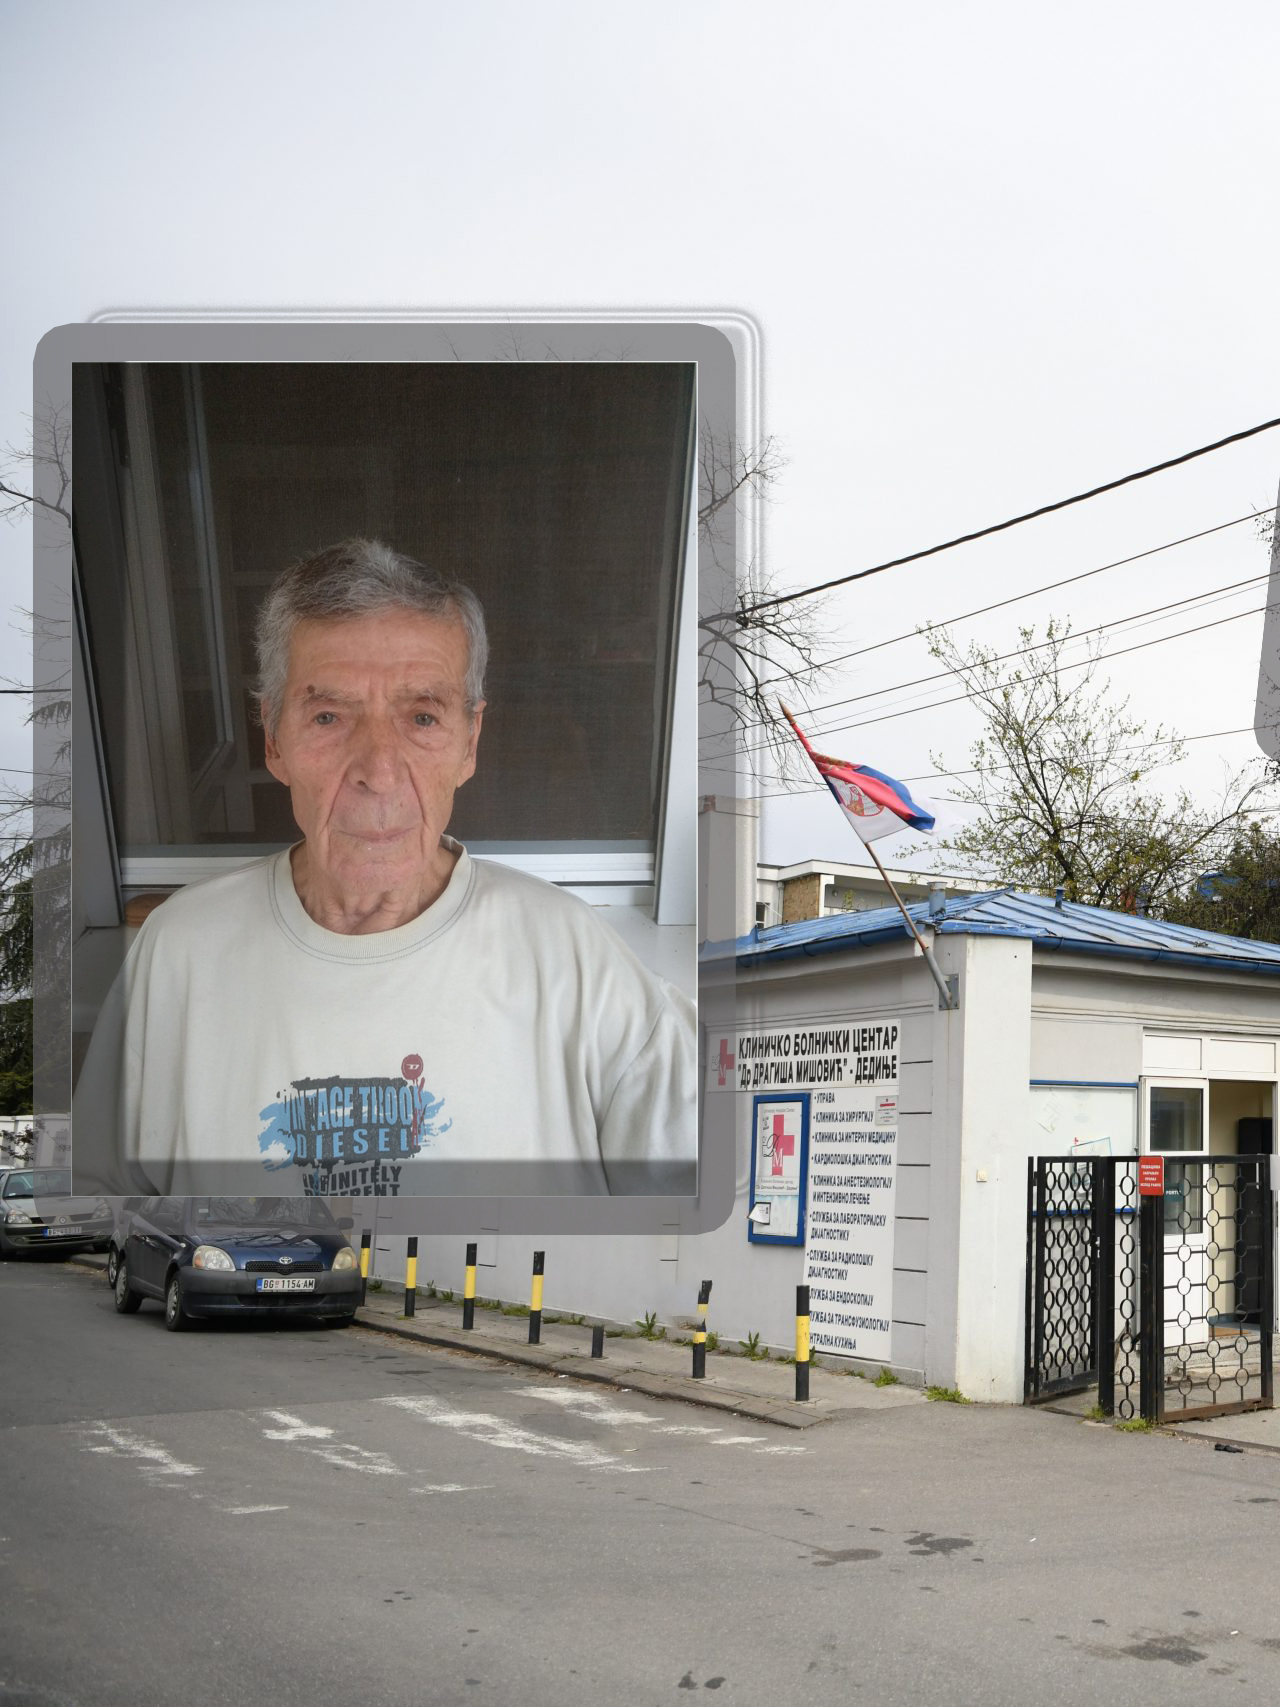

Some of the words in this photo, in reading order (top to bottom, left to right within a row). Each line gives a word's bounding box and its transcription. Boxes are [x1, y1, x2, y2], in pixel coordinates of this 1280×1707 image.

[739, 1034, 791, 1059] КЛИНИЧКО
[794, 1029, 850, 1056] БОЛНИЧКИ
[853, 1025, 898, 1055] ЦЕНТАР
[753, 1061, 793, 1088] ДРАГИША
[855, 1055, 897, 1085] ДЕДИЊЕ
[816, 1092, 835, 1104] УПРАВА
[815, 1111, 838, 1123] КЛИНИКА
[838, 1111, 845, 1122] ЗА
[845, 1110, 874, 1123] ХИРУРГИЈУ
[297, 1128, 409, 1160] DIESEL
[814, 1131, 838, 1143] КЛИНИКА
[838, 1131, 845, 1143] ЗА
[845, 1131, 867, 1143] ИНТЕРНУ
[868, 1131, 896, 1144] МЕДИЦИНУ
[814, 1153, 851, 1166] КАРДИОЛОШКА
[852, 1154, 892, 1166] ДИЈАГНОСТИКА
[303, 1166, 402, 1192] INFINITELY
[813, 1174, 836, 1187] КЛИНИКА
[837, 1175, 843, 1187] ЗА
[843, 1175, 893, 1189] АНЕСТЕЗИОЛОГИЈУ
[817, 1191, 849, 1204] ИНТЕНЗИВНО
[849, 1192, 870, 1205] ЛЕЧЕЊЕ
[812, 1211, 833, 1223] СЛУЖБА
[833, 1212, 839, 1223] ЗА
[839, 1212, 886, 1227] ЛАБОРАТОРИЈСКУ
[811, 1227, 850, 1241] ДИЈАГНОСТИКУ
[809, 1249, 831, 1262] СЛУЖБА
[831, 1251, 838, 1263] ЗА
[838, 1252, 874, 1266] РАДИОЛОШКУ
[807, 1265, 848, 1281] ДИЈАГНОСТИКУ
[263, 1280, 274, 1289] BG
[809, 1287, 829, 1301] ЛУЖБА
[829, 1289, 836, 1301] ЗА
[836, 1290, 874, 1307] ЕНДОСКОПИЈУ
[809, 1311, 827, 1324] ЛУЖБА
[827, 1312, 834, 1324] ЗА
[835, 1313, 890, 1332] ТРАНСФУЗИОЛОГИЈУ
[834, 1335, 857, 1350] КУХИЊА
